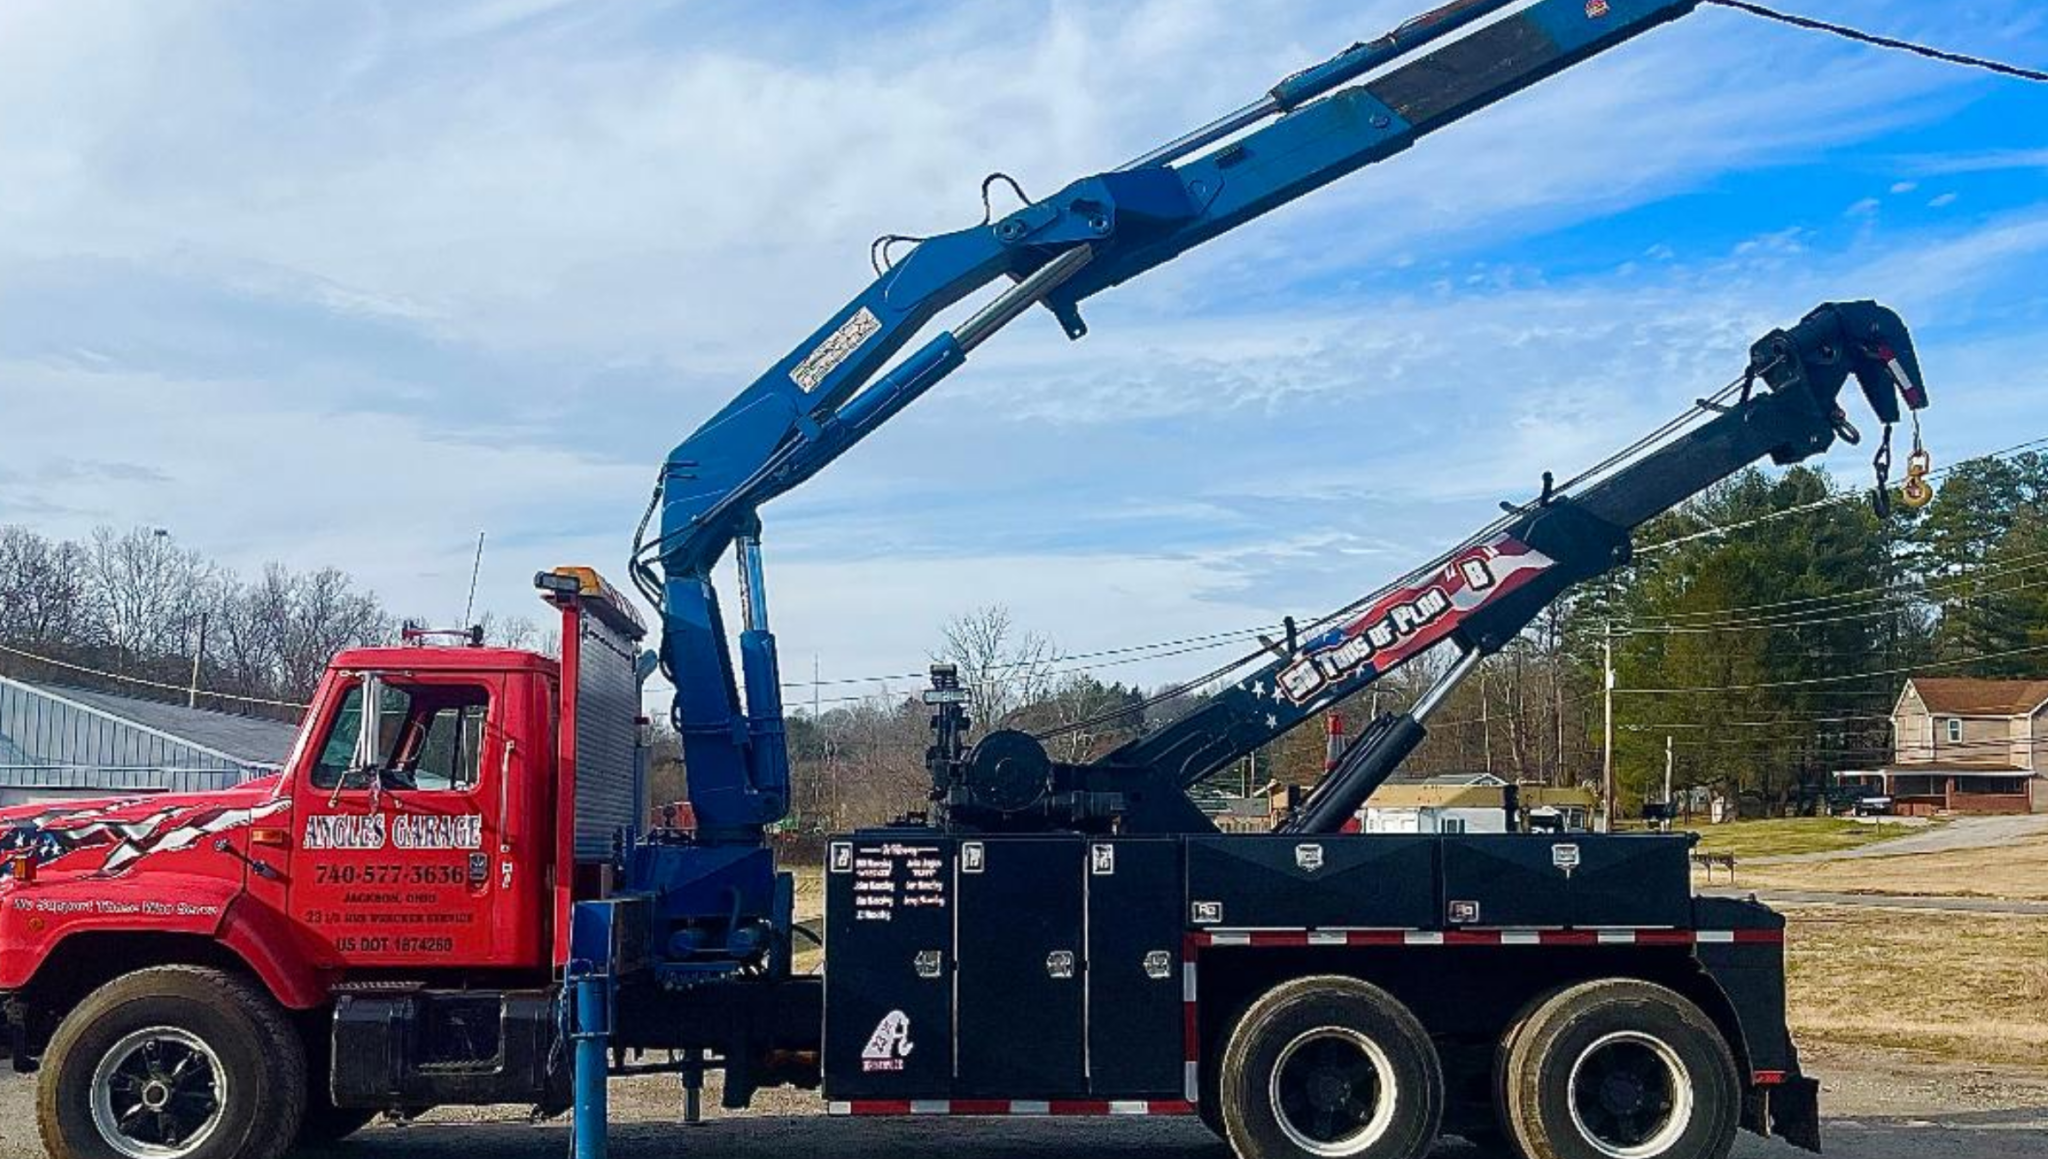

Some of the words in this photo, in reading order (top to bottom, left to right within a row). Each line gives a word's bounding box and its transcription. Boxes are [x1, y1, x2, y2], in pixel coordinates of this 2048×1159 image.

[392, 813, 482, 849] GARAGE
[315, 865, 465, 884] 740-577-3636
[406, 892, 437, 904] OHIO
[305, 910, 322, 923] 23
[336, 937, 357, 951] US
[360, 937, 389, 951] DOT
